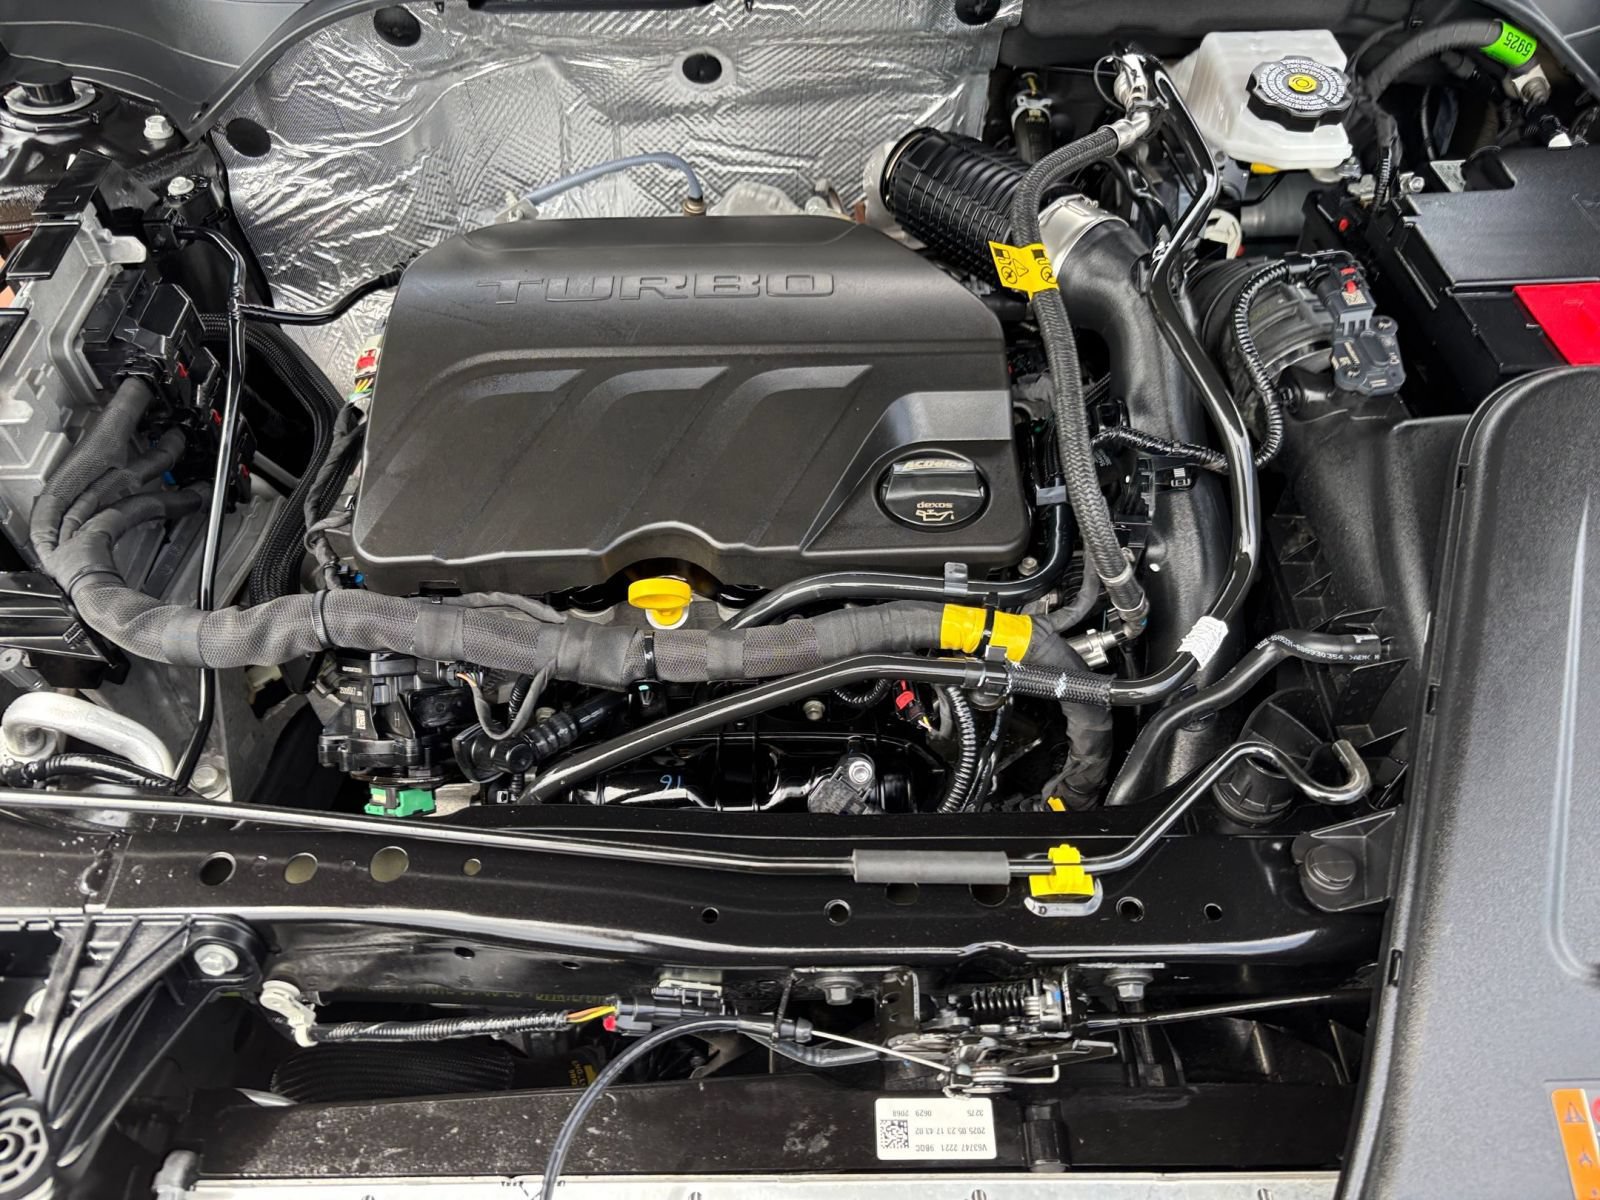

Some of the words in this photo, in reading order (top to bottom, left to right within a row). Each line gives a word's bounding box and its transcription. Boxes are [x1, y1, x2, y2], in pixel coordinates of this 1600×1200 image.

[1503, 32, 1532, 57] 5925
[476, 273, 835, 304] TURBO
[902, 459, 967, 470] ACDelco
[916, 501, 954, 509] dexos
